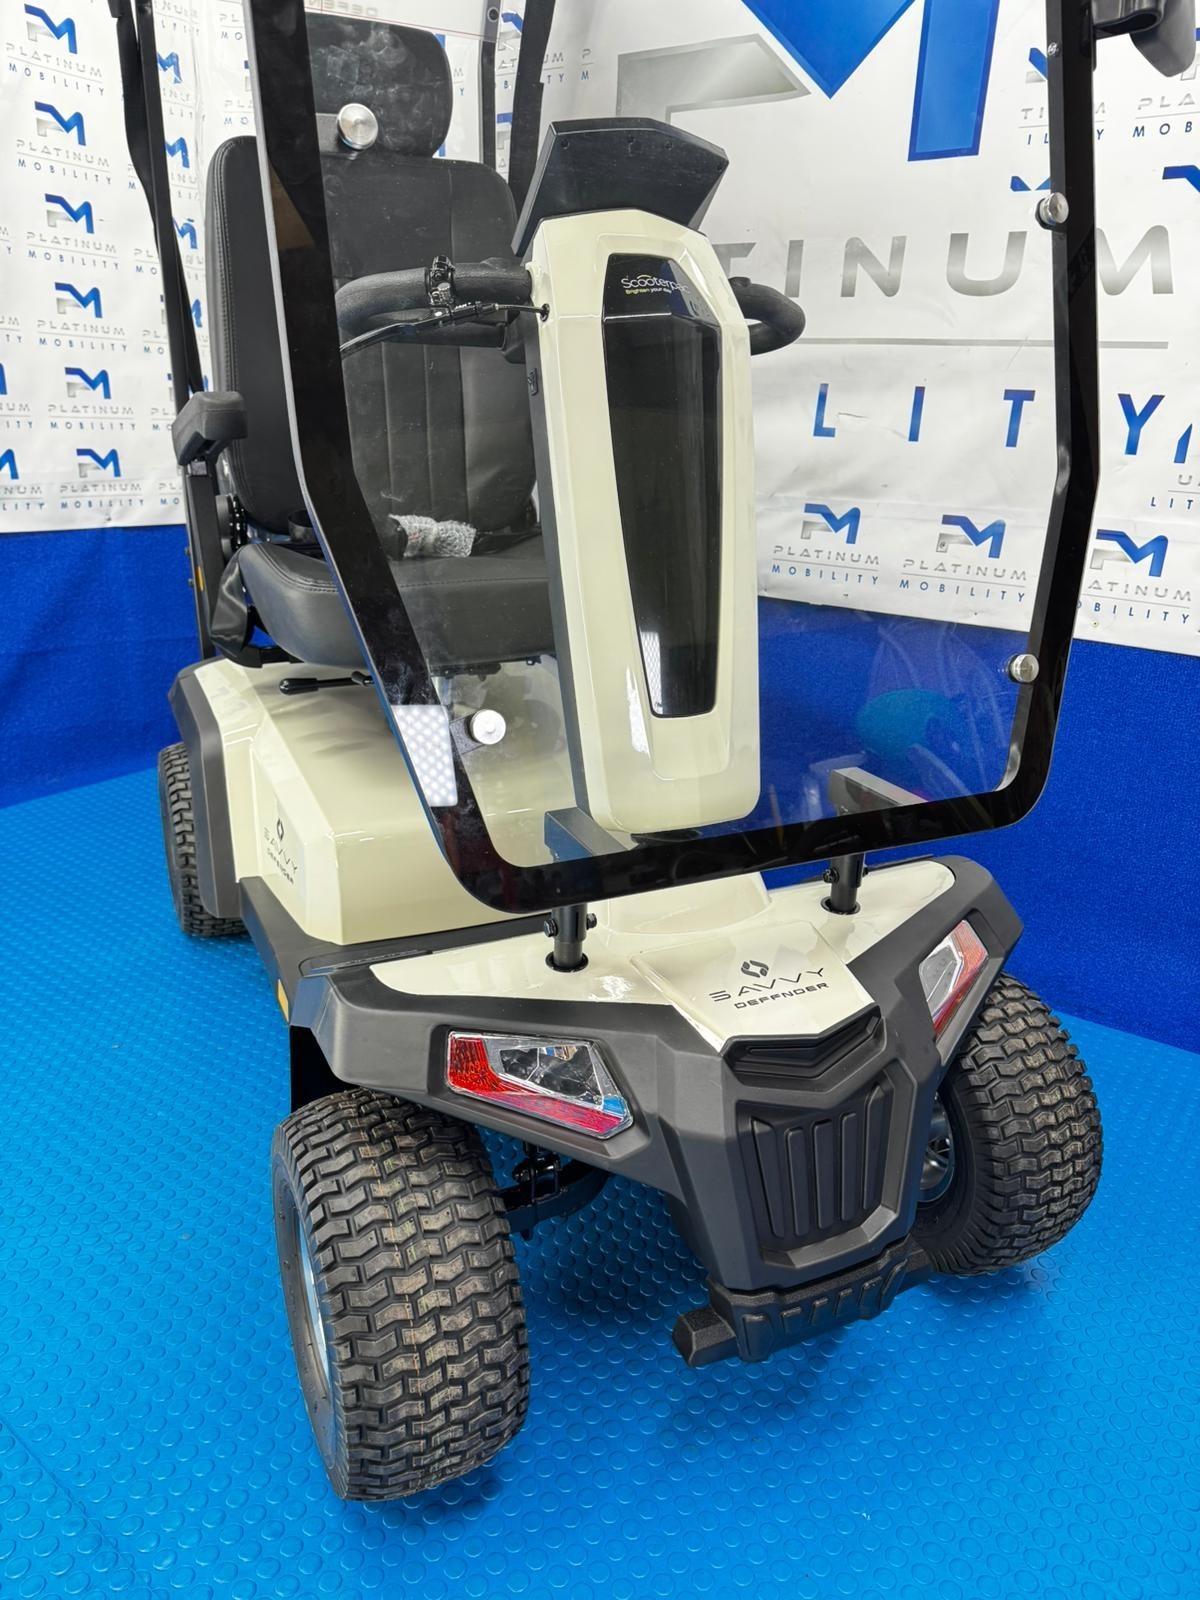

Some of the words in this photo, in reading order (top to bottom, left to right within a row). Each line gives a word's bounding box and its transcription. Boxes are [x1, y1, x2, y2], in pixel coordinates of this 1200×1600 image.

[6, 43, 103, 78] PLATINUM
[9, 63, 104, 97] MOBILITY
[17, 139, 110, 168] PLATINUM
[18, 158, 112, 185] MOBILITY
[26, 231, 118, 254] PLATINUM
[28, 249, 119, 270] MOBILITY
[37, 319, 126, 336] PLATINUM
[39, 337, 128, 352] MOBILITY
[47, 404, 134, 415] PLATINUM
[50, 421, 136, 431] MOBILITY
[59, 482, 143, 493] PLATINUM
[60, 499, 144, 510] MOBILITY
[773, 545, 880, 566] PLATINUM
[771, 564, 880, 586] MOBILITY
[902, 558, 1028, 581] PLATINUM
[899, 579, 1026, 602] MOBILITY
[709, 968, 824, 1002] SAVVY
[734, 982, 829, 1009] DEFFNDER
